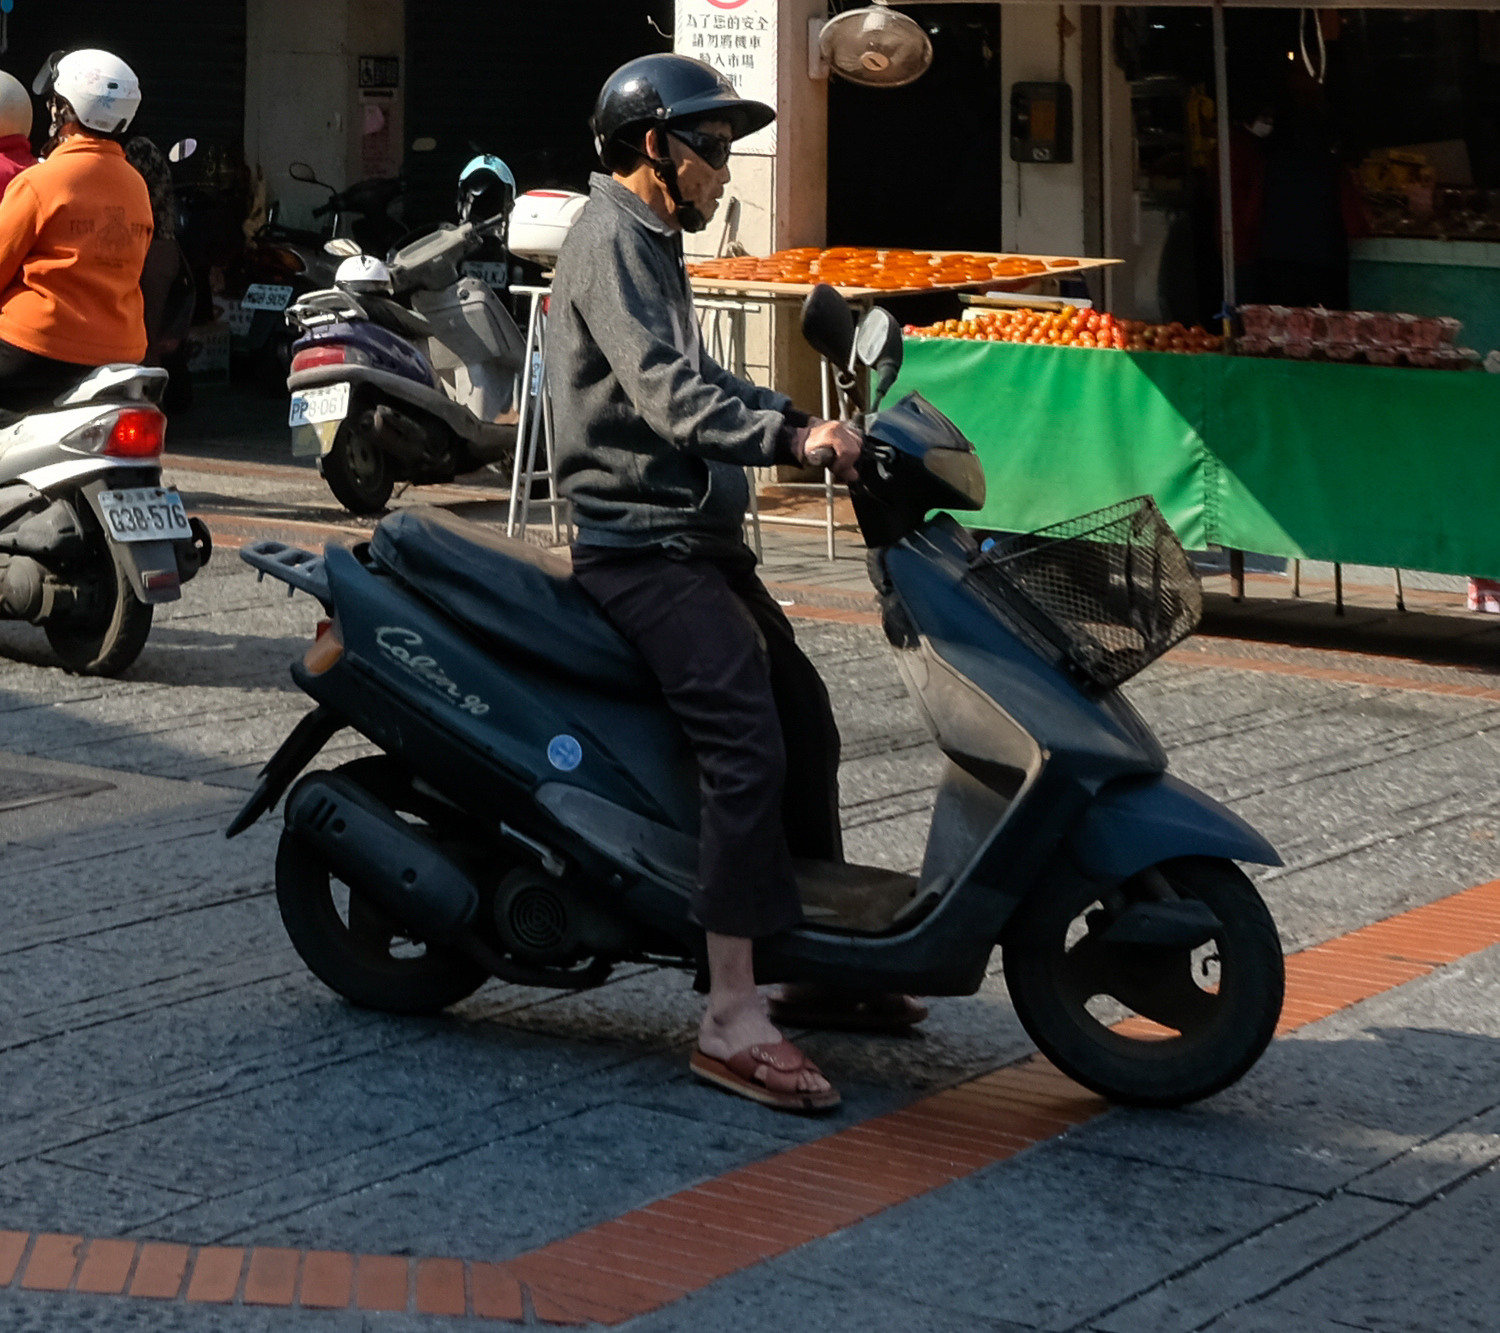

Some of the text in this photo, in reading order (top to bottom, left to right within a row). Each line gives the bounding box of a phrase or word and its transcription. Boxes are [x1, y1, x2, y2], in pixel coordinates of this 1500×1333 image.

[686, 13, 769, 31] 為了您的安全
[692, 33, 762, 49] 請勿將機車
